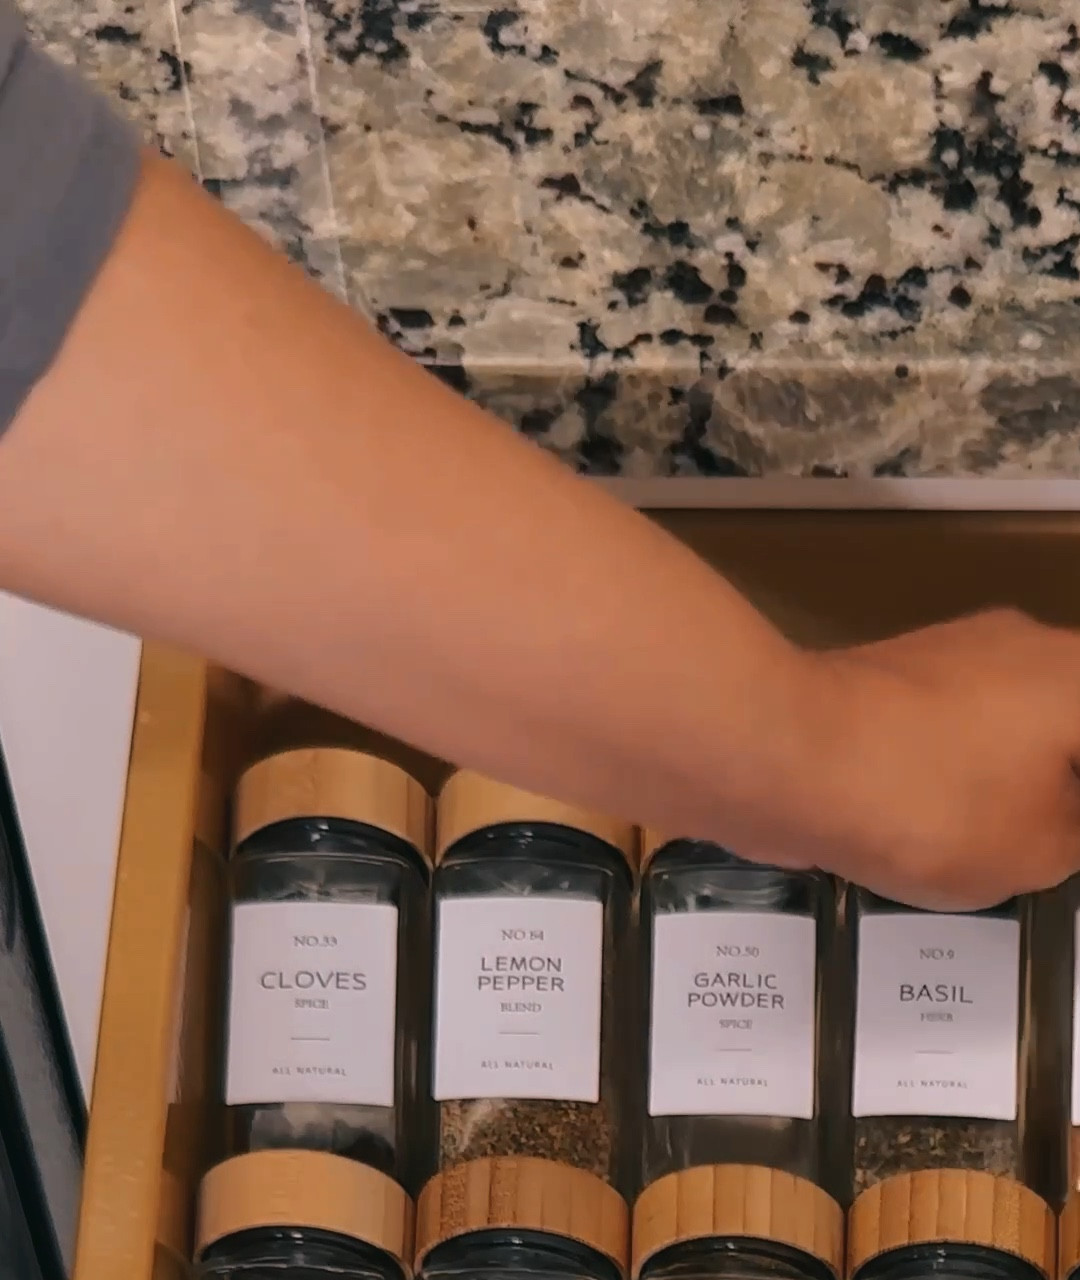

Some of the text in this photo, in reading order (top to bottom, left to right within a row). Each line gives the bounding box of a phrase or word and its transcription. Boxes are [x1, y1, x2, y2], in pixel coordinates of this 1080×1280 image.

[482, 957, 561, 972] LEMON
[260, 971, 366, 990] CLOVES
[478, 975, 564, 992] PEPPER
[695, 973, 777, 990] GARLIC
[688, 992, 784, 1009] POWDER
[900, 985, 972, 1003] BASIL
[272, 1067, 347, 1077] ALL NATURAL
[481, 1061, 553, 1071] ALL NATURAL
[697, 1078, 768, 1087] ALL NATURAL
[898, 1080, 970, 1089] ALL NATURAL
